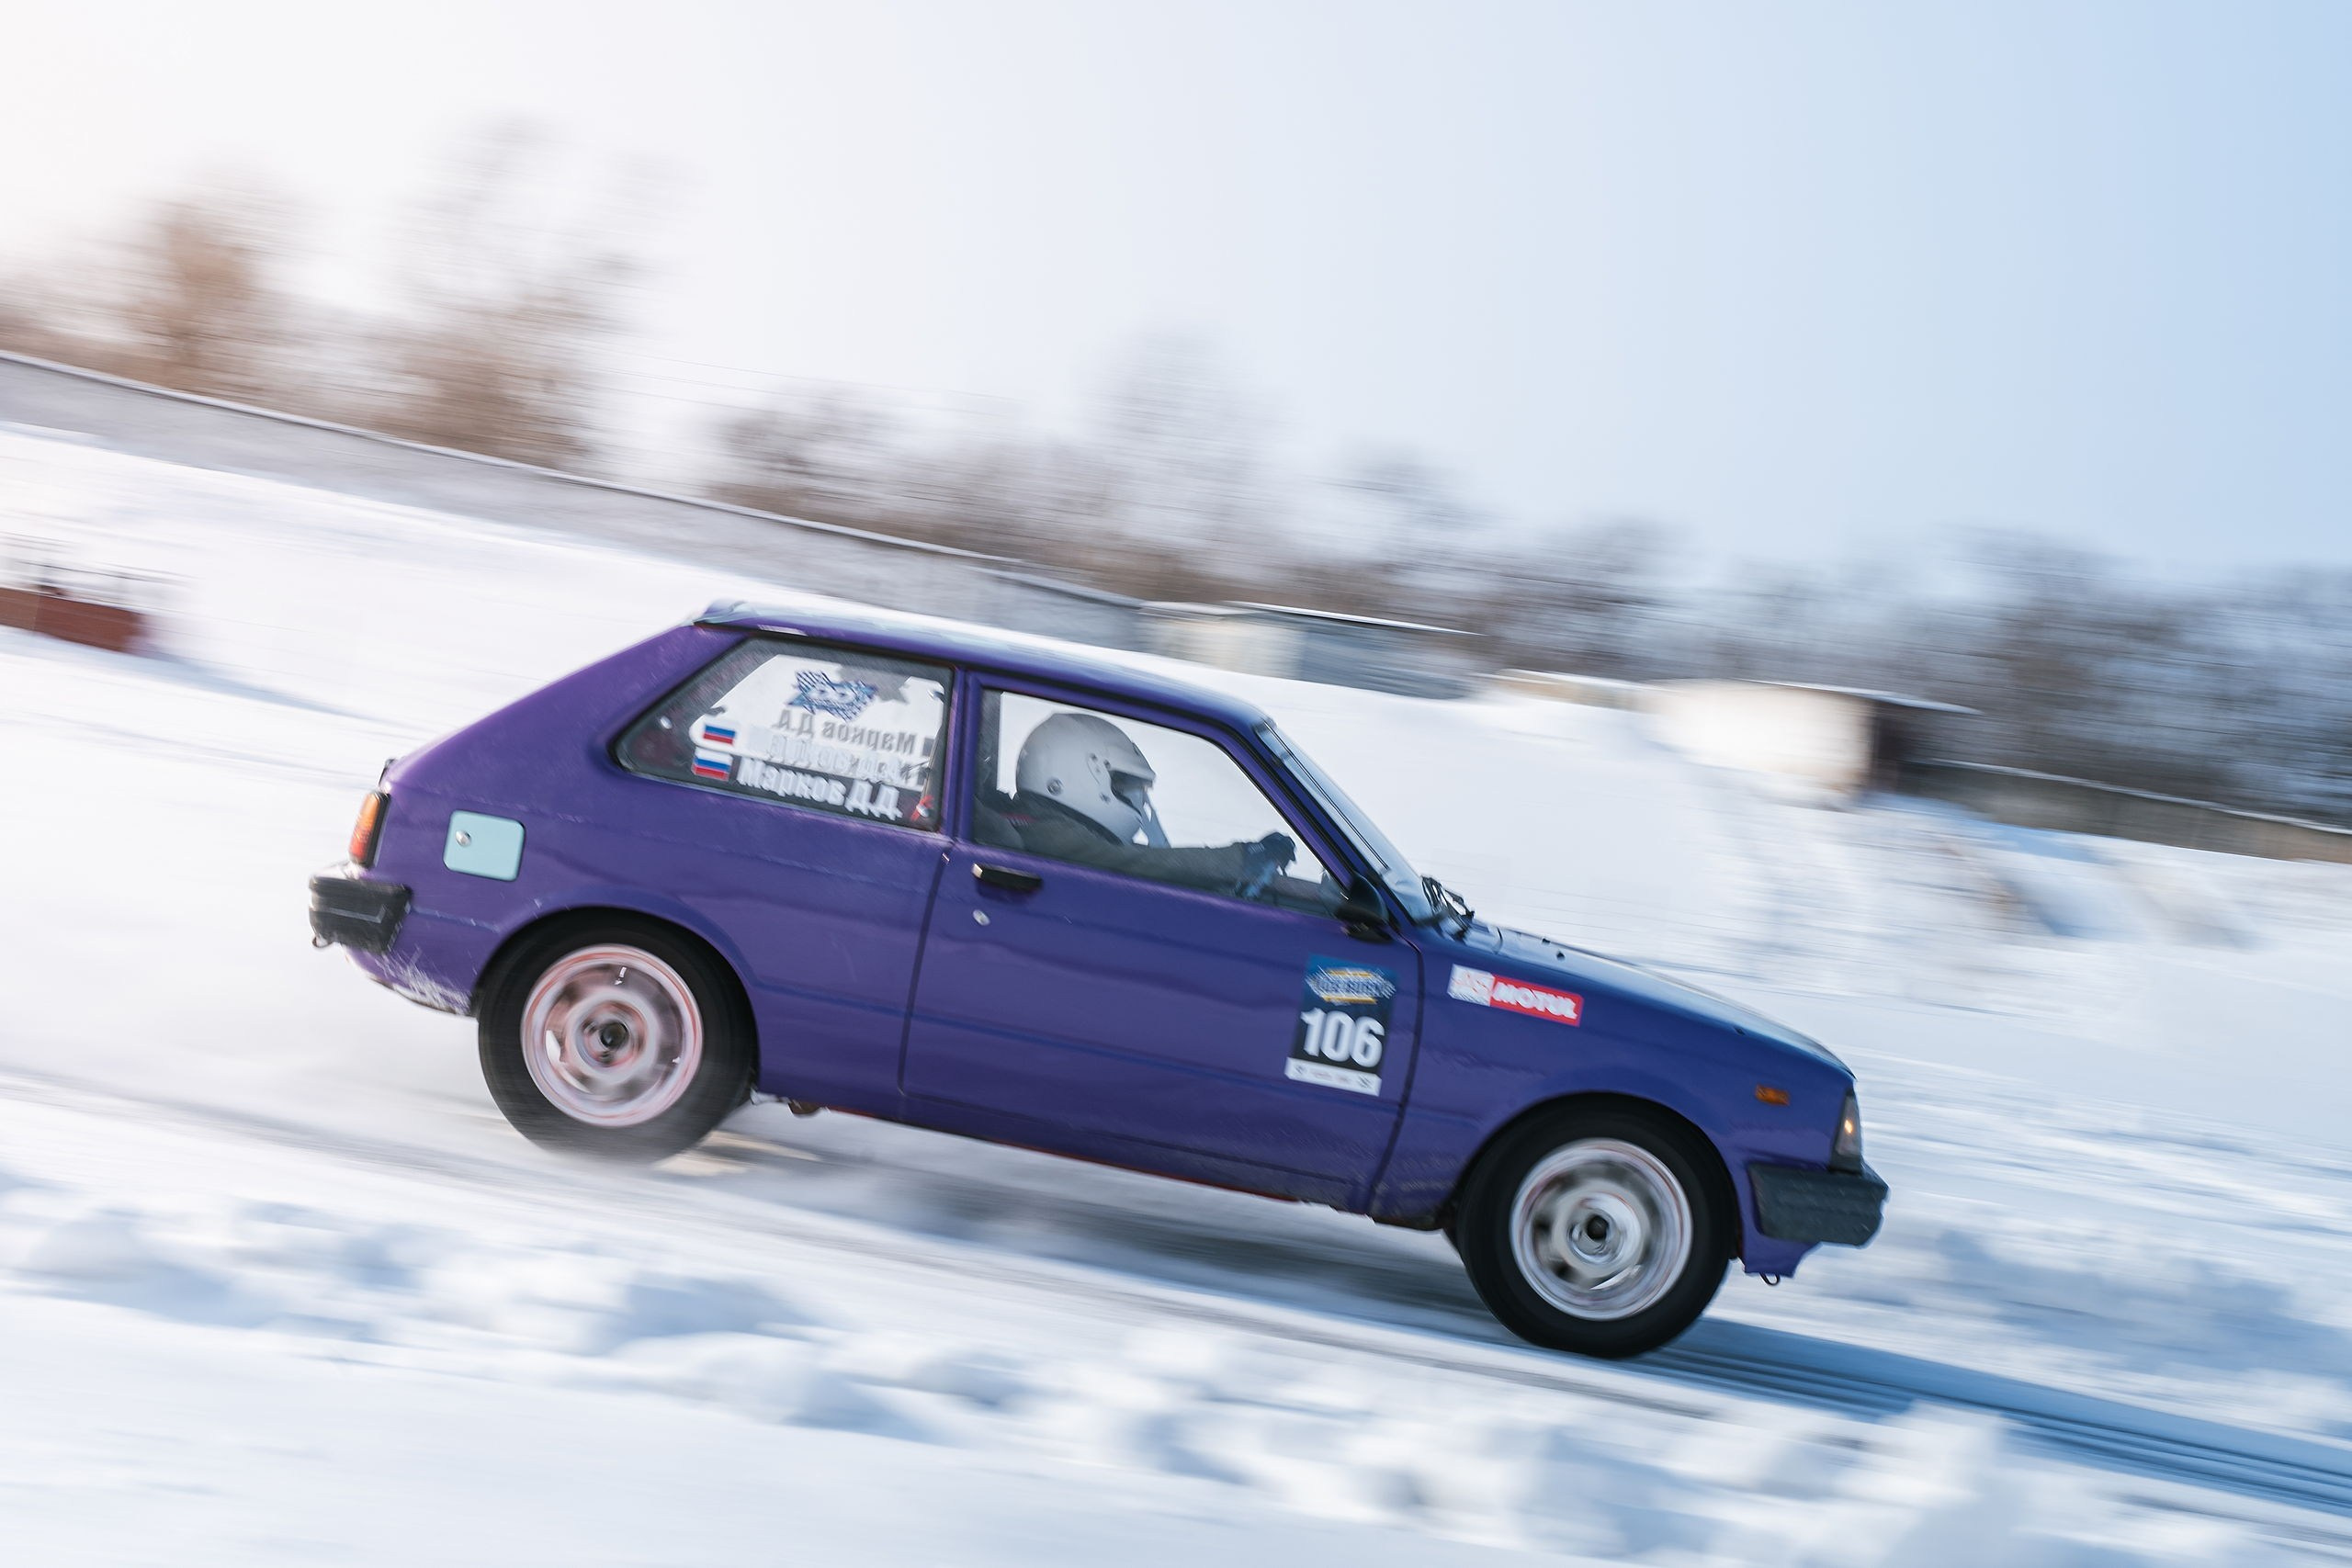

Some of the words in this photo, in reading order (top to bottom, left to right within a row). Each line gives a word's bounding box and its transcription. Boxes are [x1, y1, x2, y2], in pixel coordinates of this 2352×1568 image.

[736, 755, 847, 807] Марков
[1492, 981, 1578, 1020] MOTUL
[1300, 1007, 1385, 1068] 106
